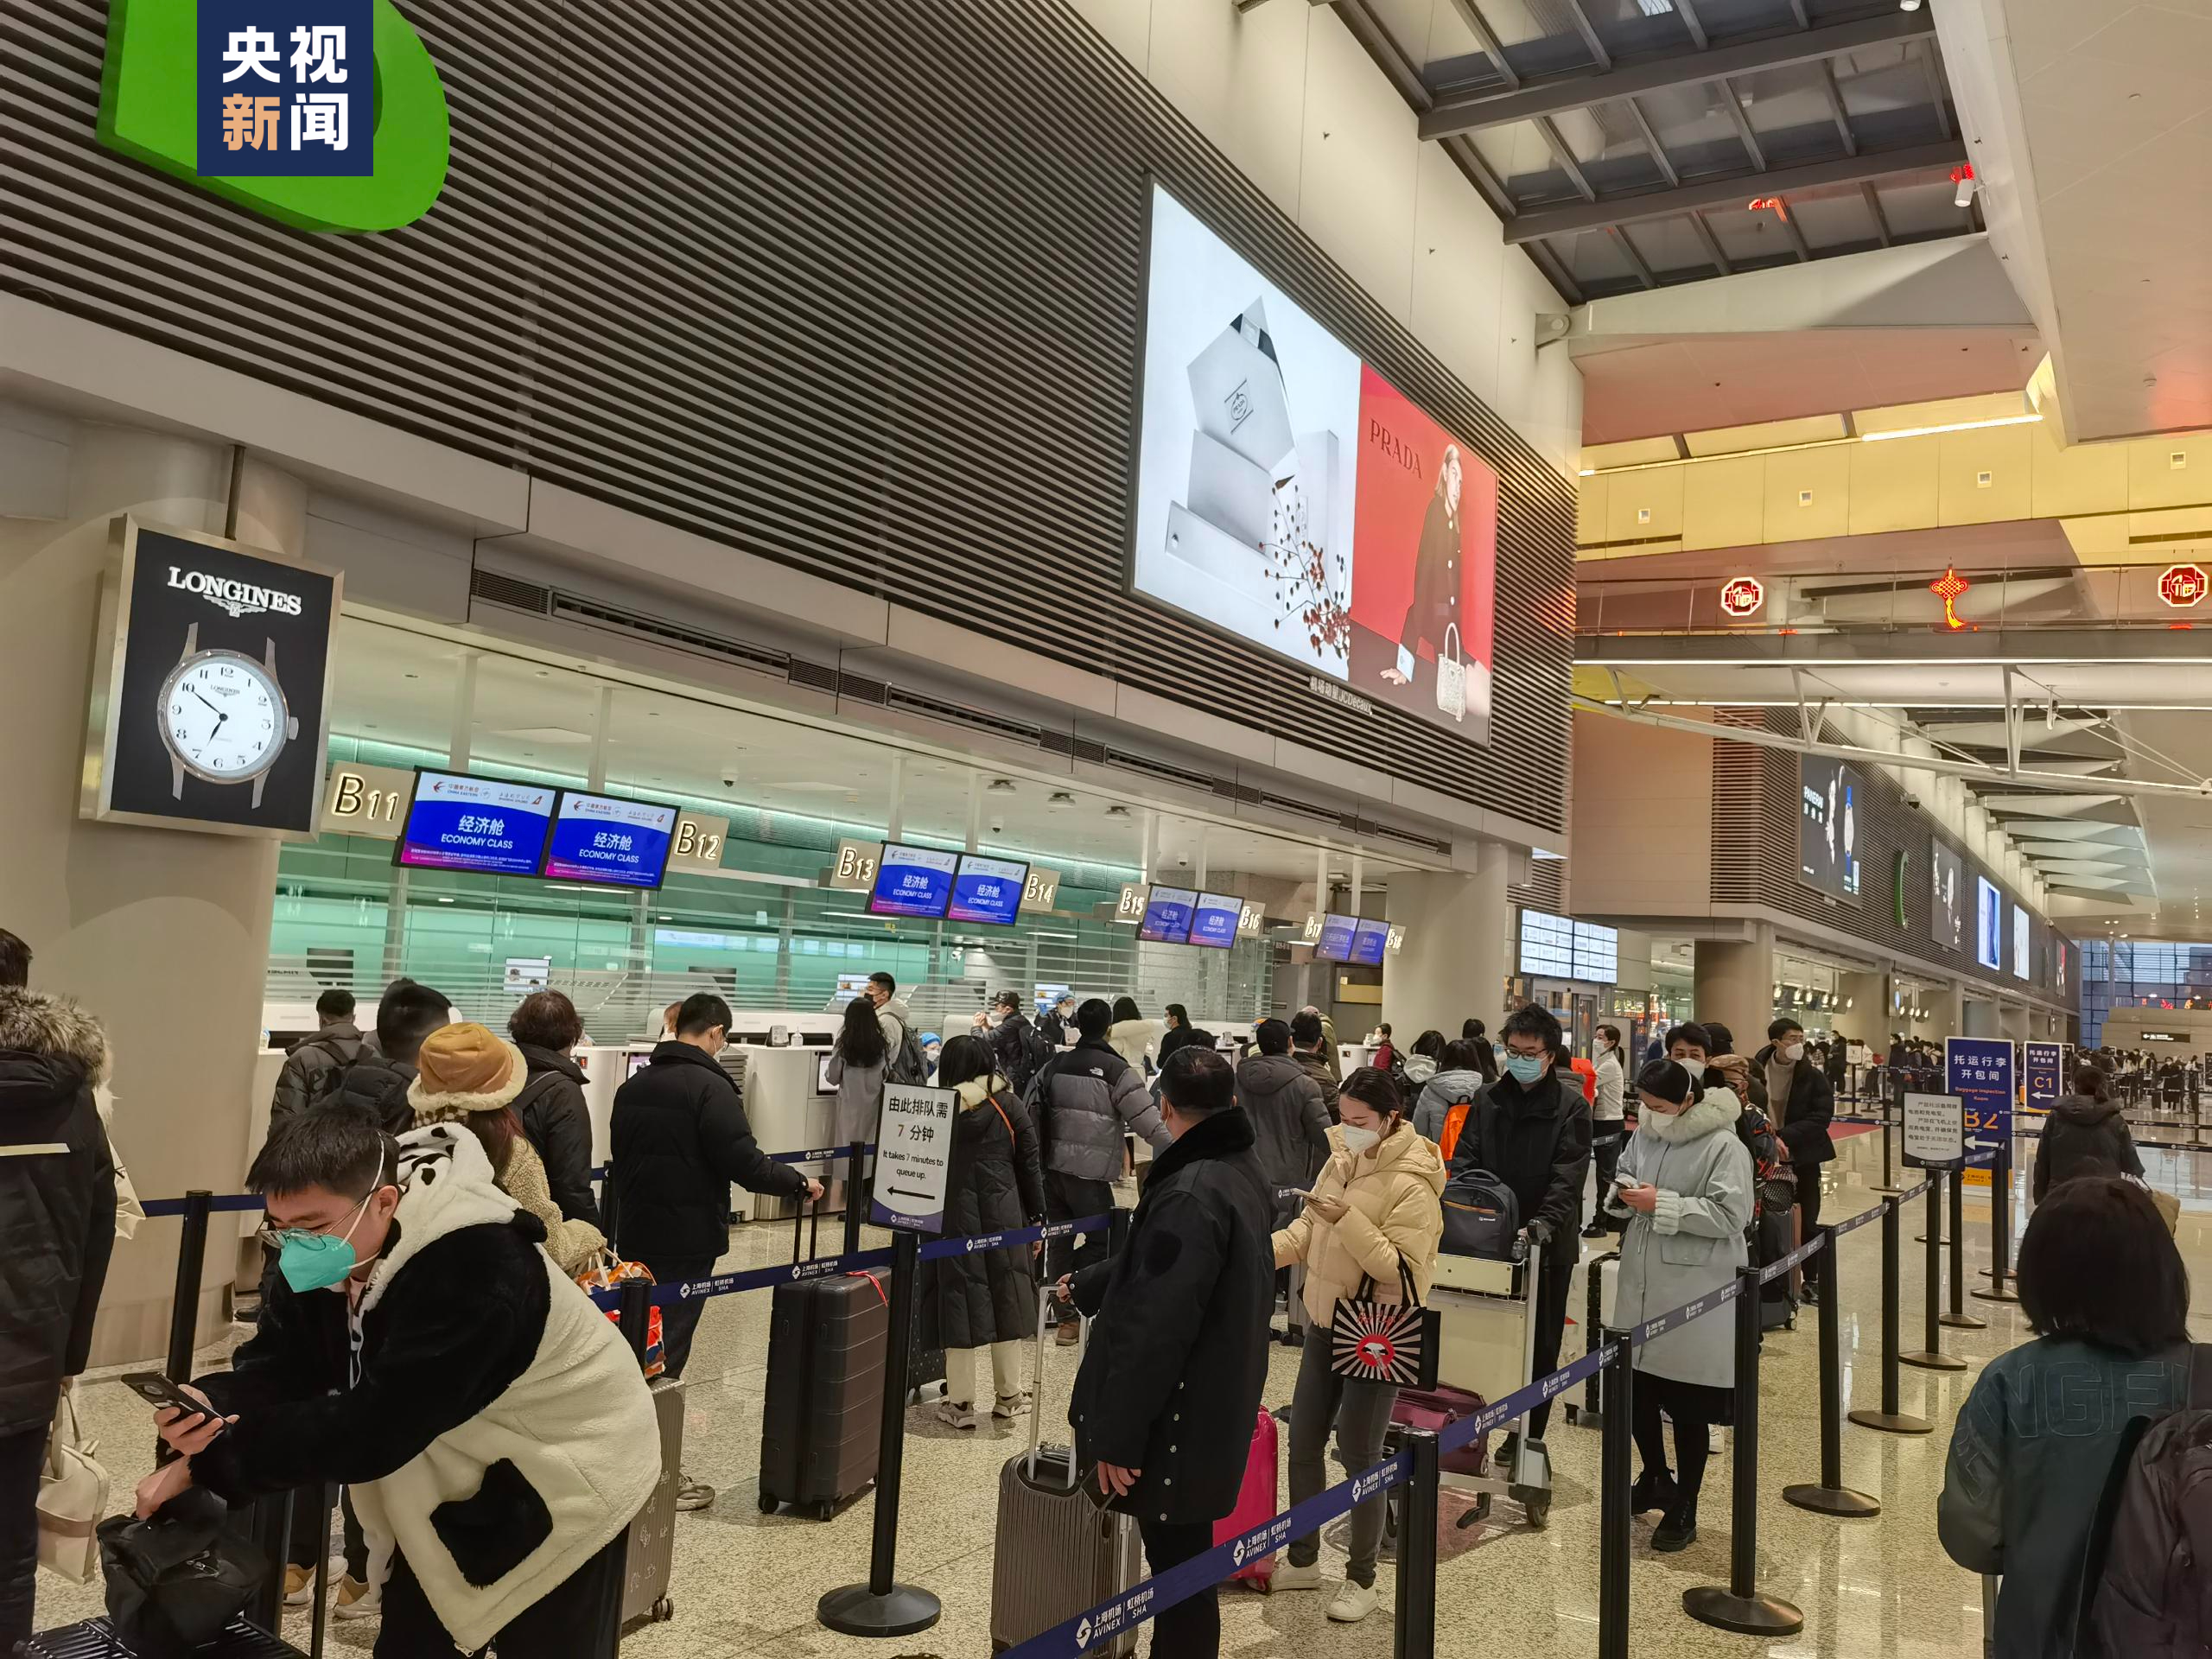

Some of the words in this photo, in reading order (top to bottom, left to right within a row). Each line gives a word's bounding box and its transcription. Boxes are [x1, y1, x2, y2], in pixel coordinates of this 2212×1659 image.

[1370, 418, 1422, 480] PRADA
[167, 566, 302, 615] LONGINES
[333, 773, 399, 821] B11
[458, 815, 505, 836] 经济舱
[441, 834, 486, 846] ECONOMY
[487, 839, 513, 849] CLASS
[593, 831, 632, 851] 经济舱
[675, 821, 721, 860] B12
[579, 849, 616, 861] ECONOMY
[618, 854, 639, 863] CLASS
[837, 847, 874, 880] B13
[893, 888, 917, 897] ECONOMY
[902, 874, 929, 889] 经济舱
[1024, 874, 1054, 903] B14
[1120, 887, 1145, 916] B15
[1238, 906, 1261, 930] B16
[1305, 916, 1322, 938] B17
[1954, 1054, 2006, 1068] 托运行李
[1961, 1069, 1999, 1082] 开包间
[2034, 1077, 2053, 1089] C1
[889, 1096, 948, 1119] 由此排队需
[898, 1124, 905, 1138] 7
[909, 1124, 934, 1143] 分钟
[883, 1150, 887, 1159] It
[888, 1150, 906, 1161] takes
[911, 1153, 936, 1166] minutes
[937, 1158, 944, 1166] to
[896, 1168, 916, 1178] queue
[916, 1172, 926, 1180] up.
[1247, 1529, 1267, 1548] 上海机场
[1271, 1517, 1291, 1536] 虹桥机场
[1246, 1541, 1267, 1559] AVINEX
[1275, 1531, 1286, 1543] SHA
[1094, 1604, 1122, 1628] 上海机场
[1127, 1587, 1154, 1611] 虹桥机场
[1094, 1618, 1121, 1639] AVINEX
[1133, 1605, 1147, 1618] SHA
